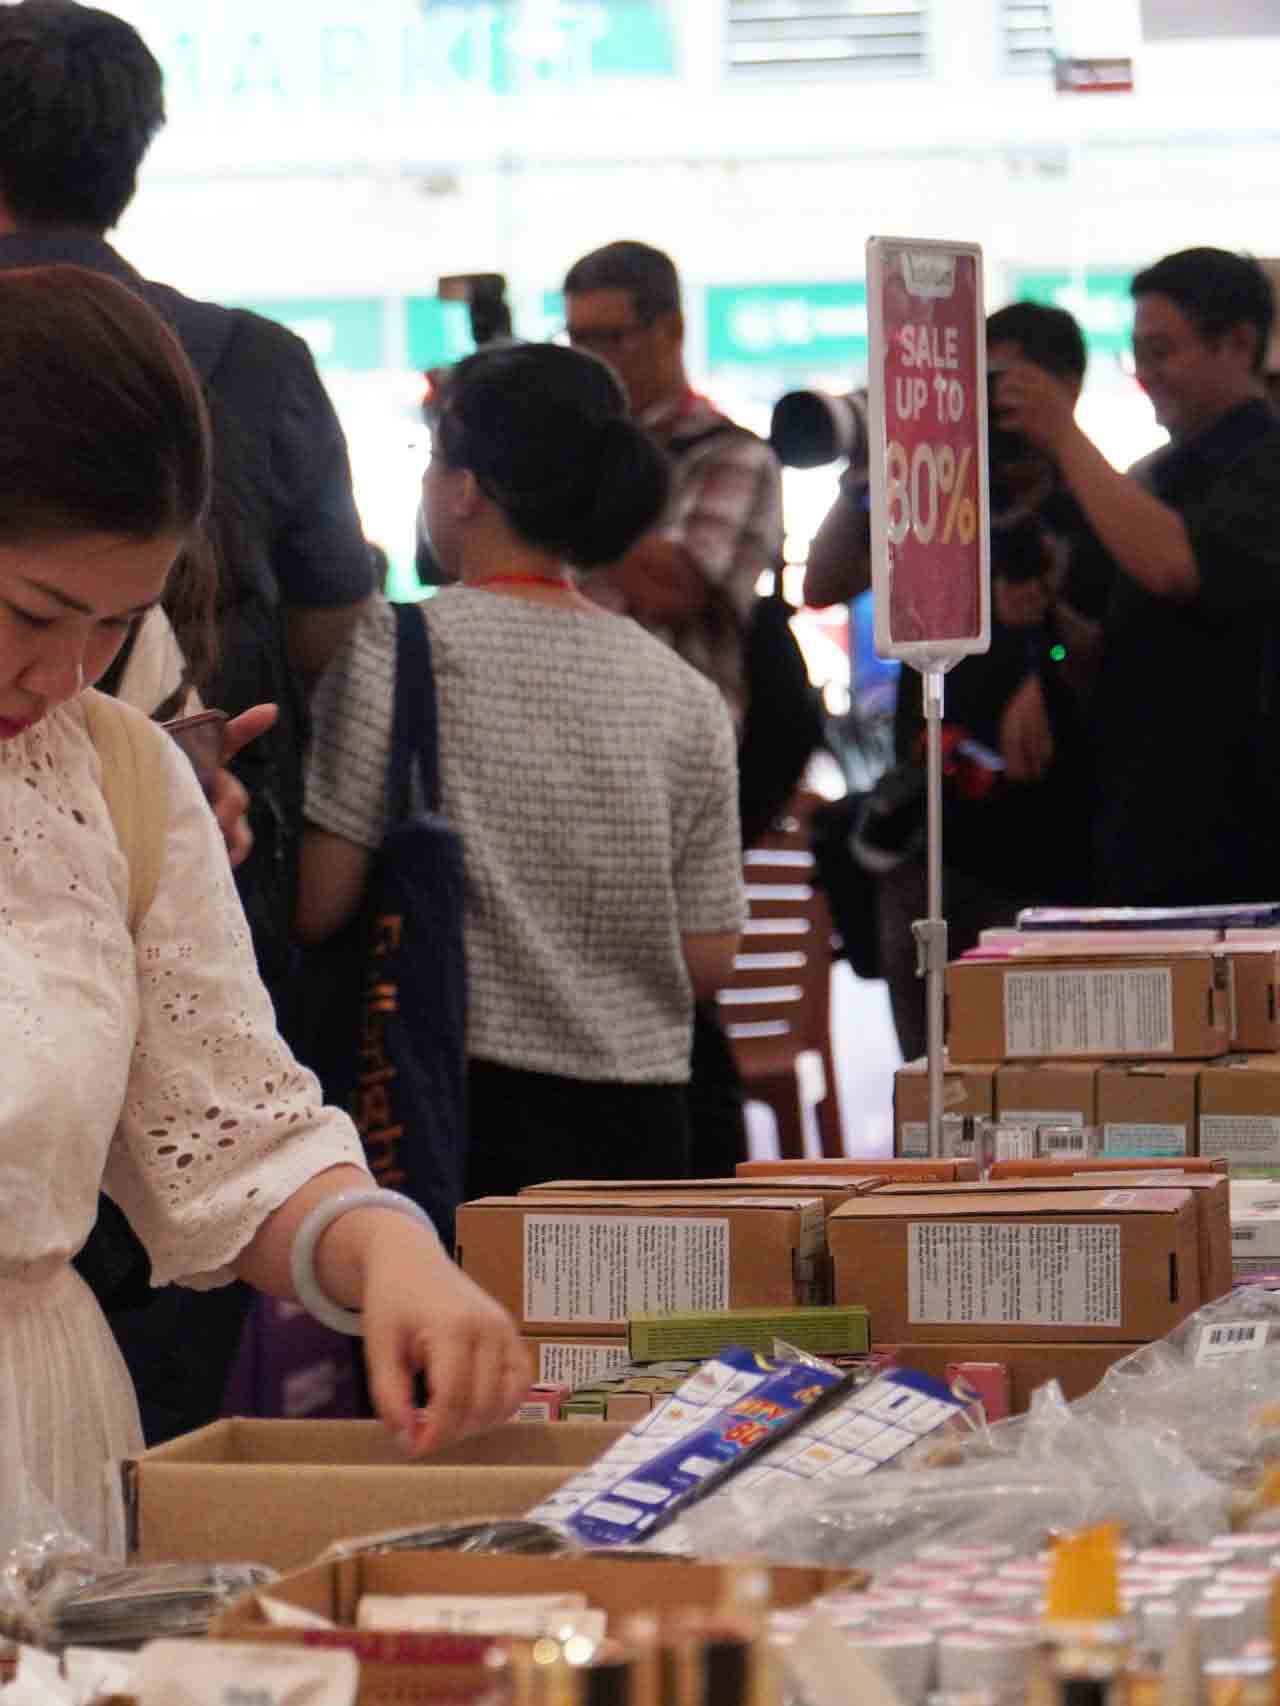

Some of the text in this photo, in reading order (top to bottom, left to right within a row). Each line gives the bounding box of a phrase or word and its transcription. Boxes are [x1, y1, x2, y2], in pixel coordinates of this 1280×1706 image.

[899, 324, 960, 368] SALE
[895, 373, 965, 424] UP TO
[887, 440, 978, 544] 80%
